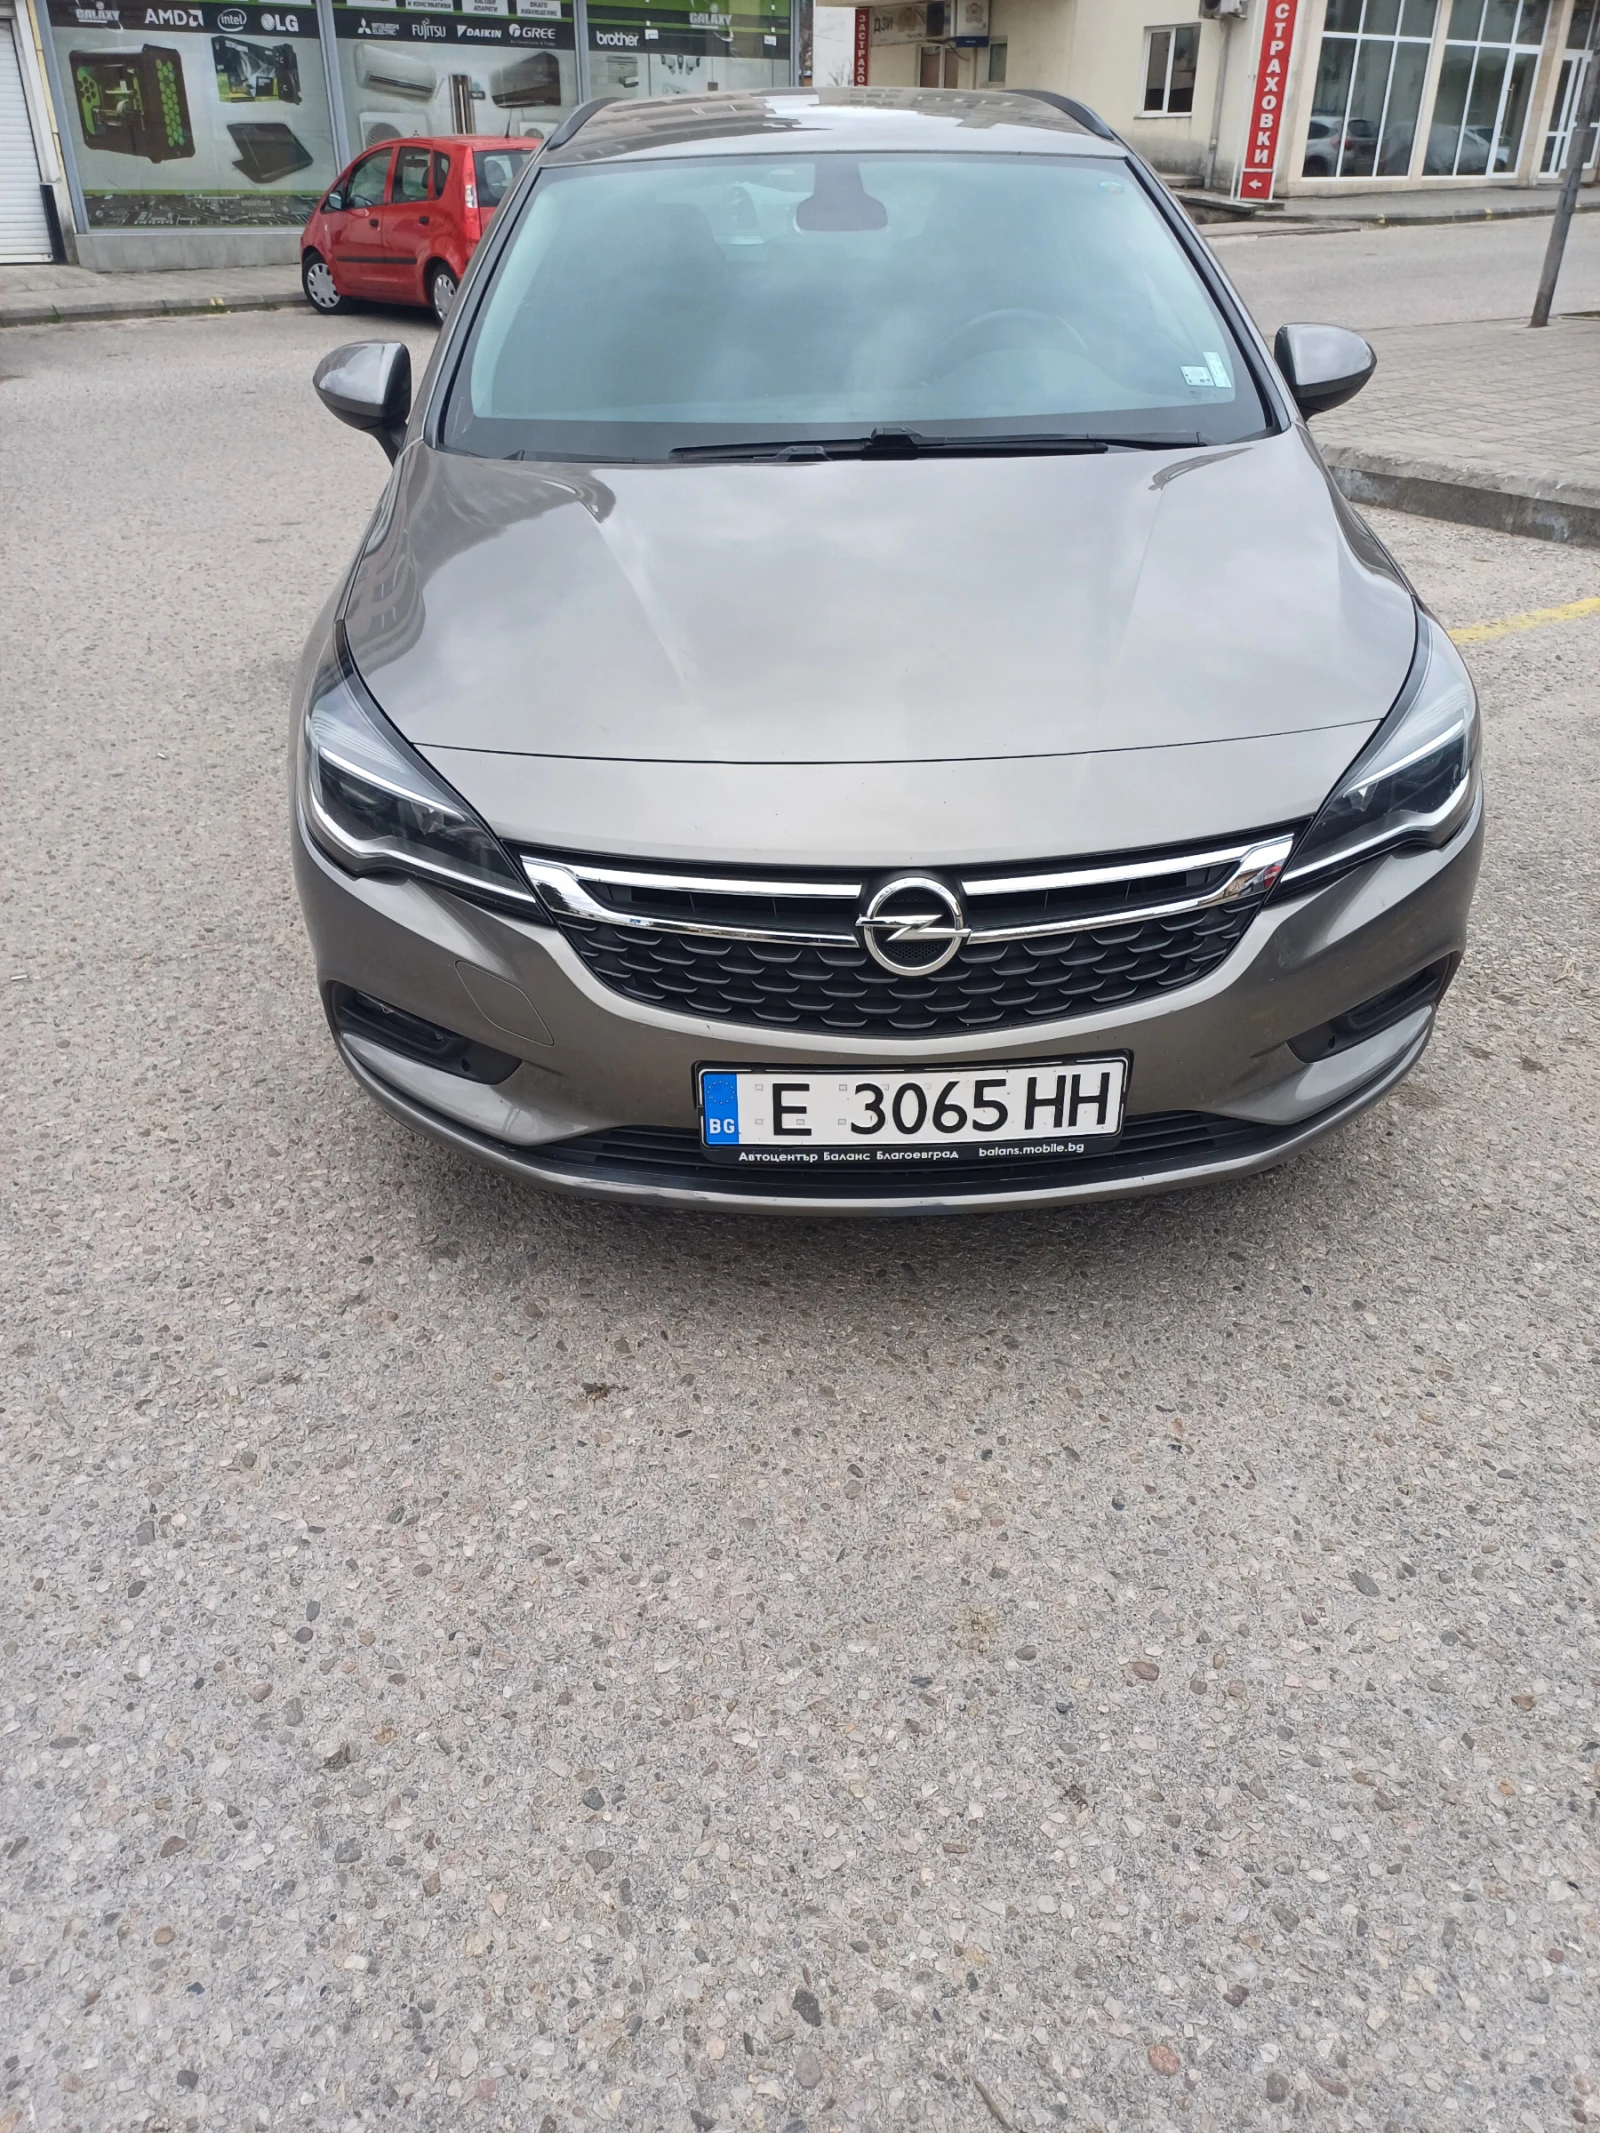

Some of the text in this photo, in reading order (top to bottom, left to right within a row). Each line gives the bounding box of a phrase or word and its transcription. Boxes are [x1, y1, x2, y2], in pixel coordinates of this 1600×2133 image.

[75, 9, 120, 21] GALAXY
[144, 8, 188, 26] AMD
[220, 13, 243, 26] intel
[274, 14, 299, 32] LG
[689, 12, 733, 26] GALAXY
[411, 18, 446, 40] FUJITSU
[874, 17, 893, 33] ДЗИ
[466, 28, 503, 39] DAIKIN
[522, 27, 556, 40] GREE
[596, 31, 639, 47] brother
[857, 14, 866, 86] ЗАСТРАХО
[772, 1083, 812, 1136] E
[709, 1118, 735, 1135] BG
[738, 1150, 959, 1163] Автоцентър Баланс Благоевград
[978, 1142, 1085, 1157] balans.mobile.bg
